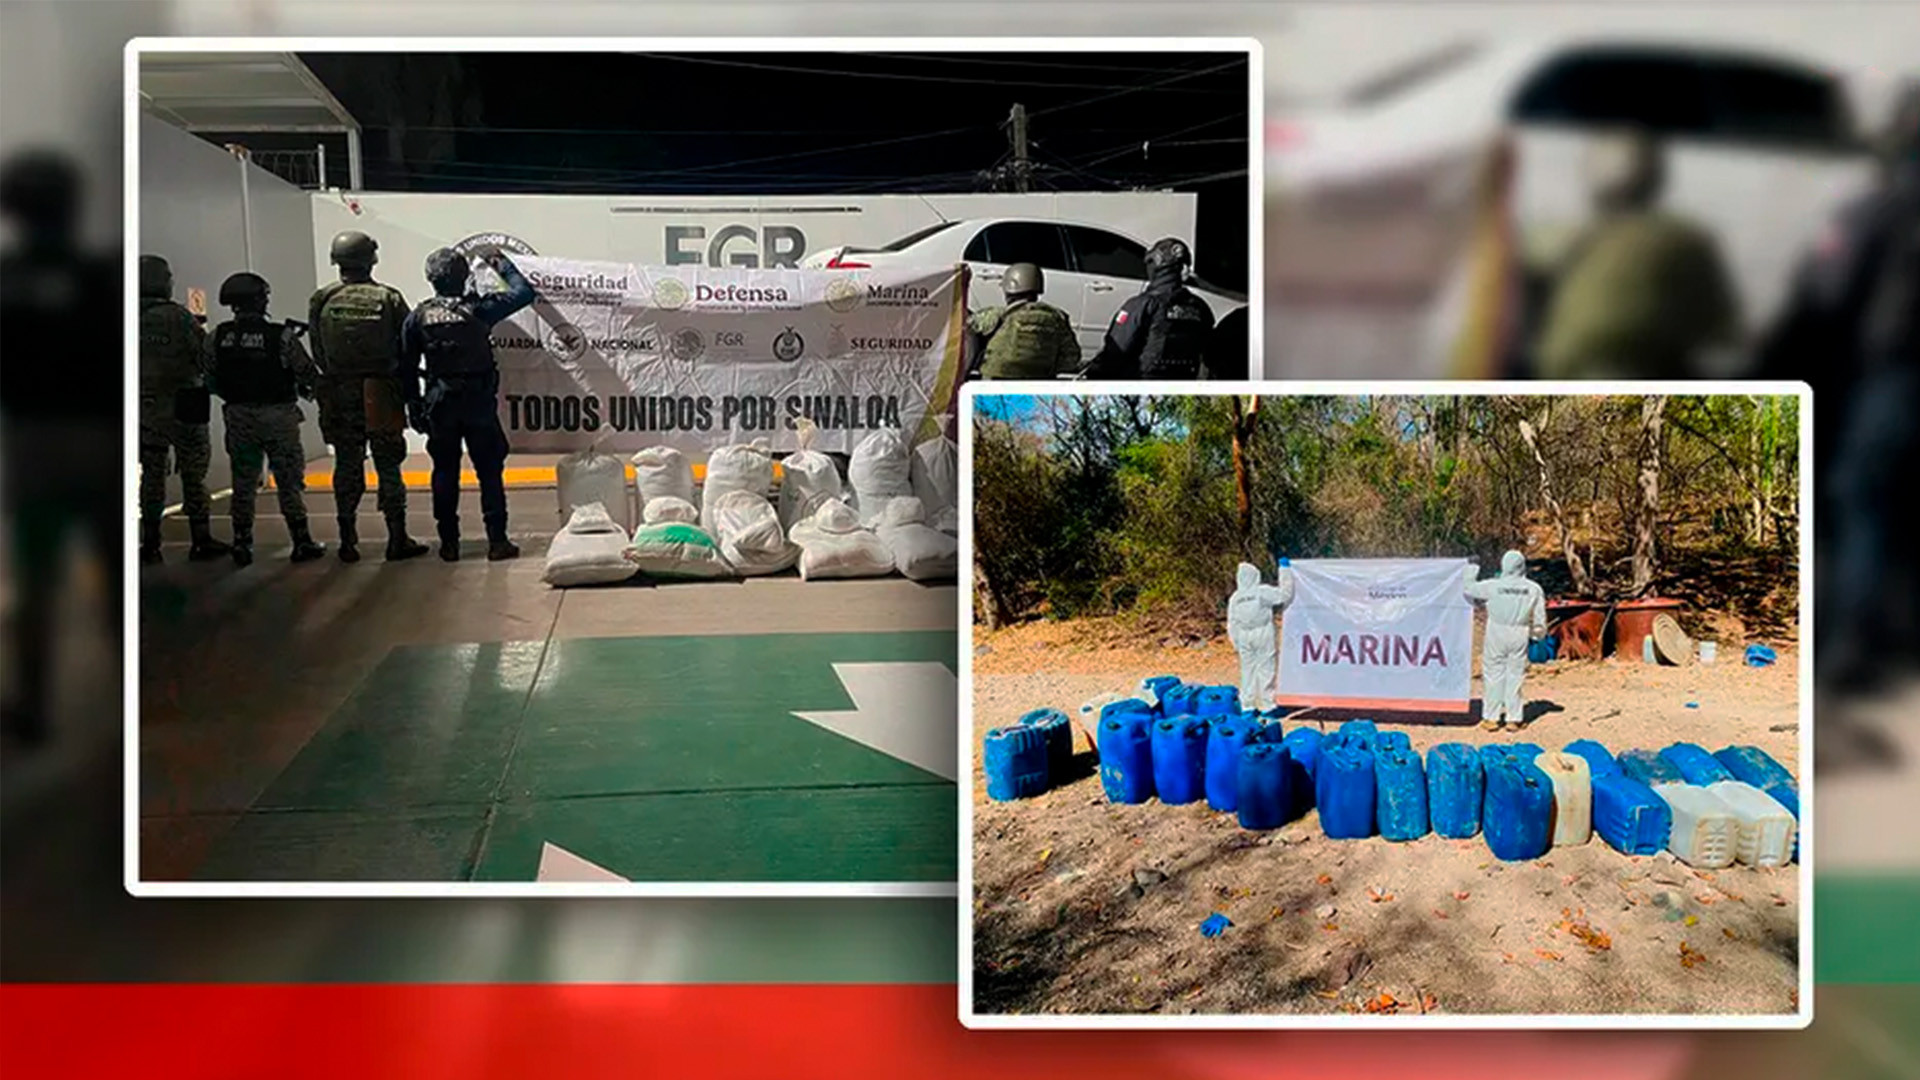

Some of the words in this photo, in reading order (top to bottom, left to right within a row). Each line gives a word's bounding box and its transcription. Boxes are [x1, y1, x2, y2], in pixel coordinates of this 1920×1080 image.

[463, 234, 506, 250] UNIDOS
[665, 224, 807, 269] FGR
[528, 270, 629, 291] Seguridad
[695, 284, 788, 301] Defensa
[866, 284, 929, 299] Marina
[489, 337, 544, 350] GUARDIA
[590, 338, 655, 350] NACIONAL
[714, 332, 744, 346] FGR
[851, 336, 933, 350] SEGURIDAD
[505, 394, 600, 433] TODOS
[609, 394, 713, 432] UNIDOS
[722, 395, 776, 432] POR
[785, 393, 901, 430] SINALOA
[1301, 633, 1448, 667] MARINA
